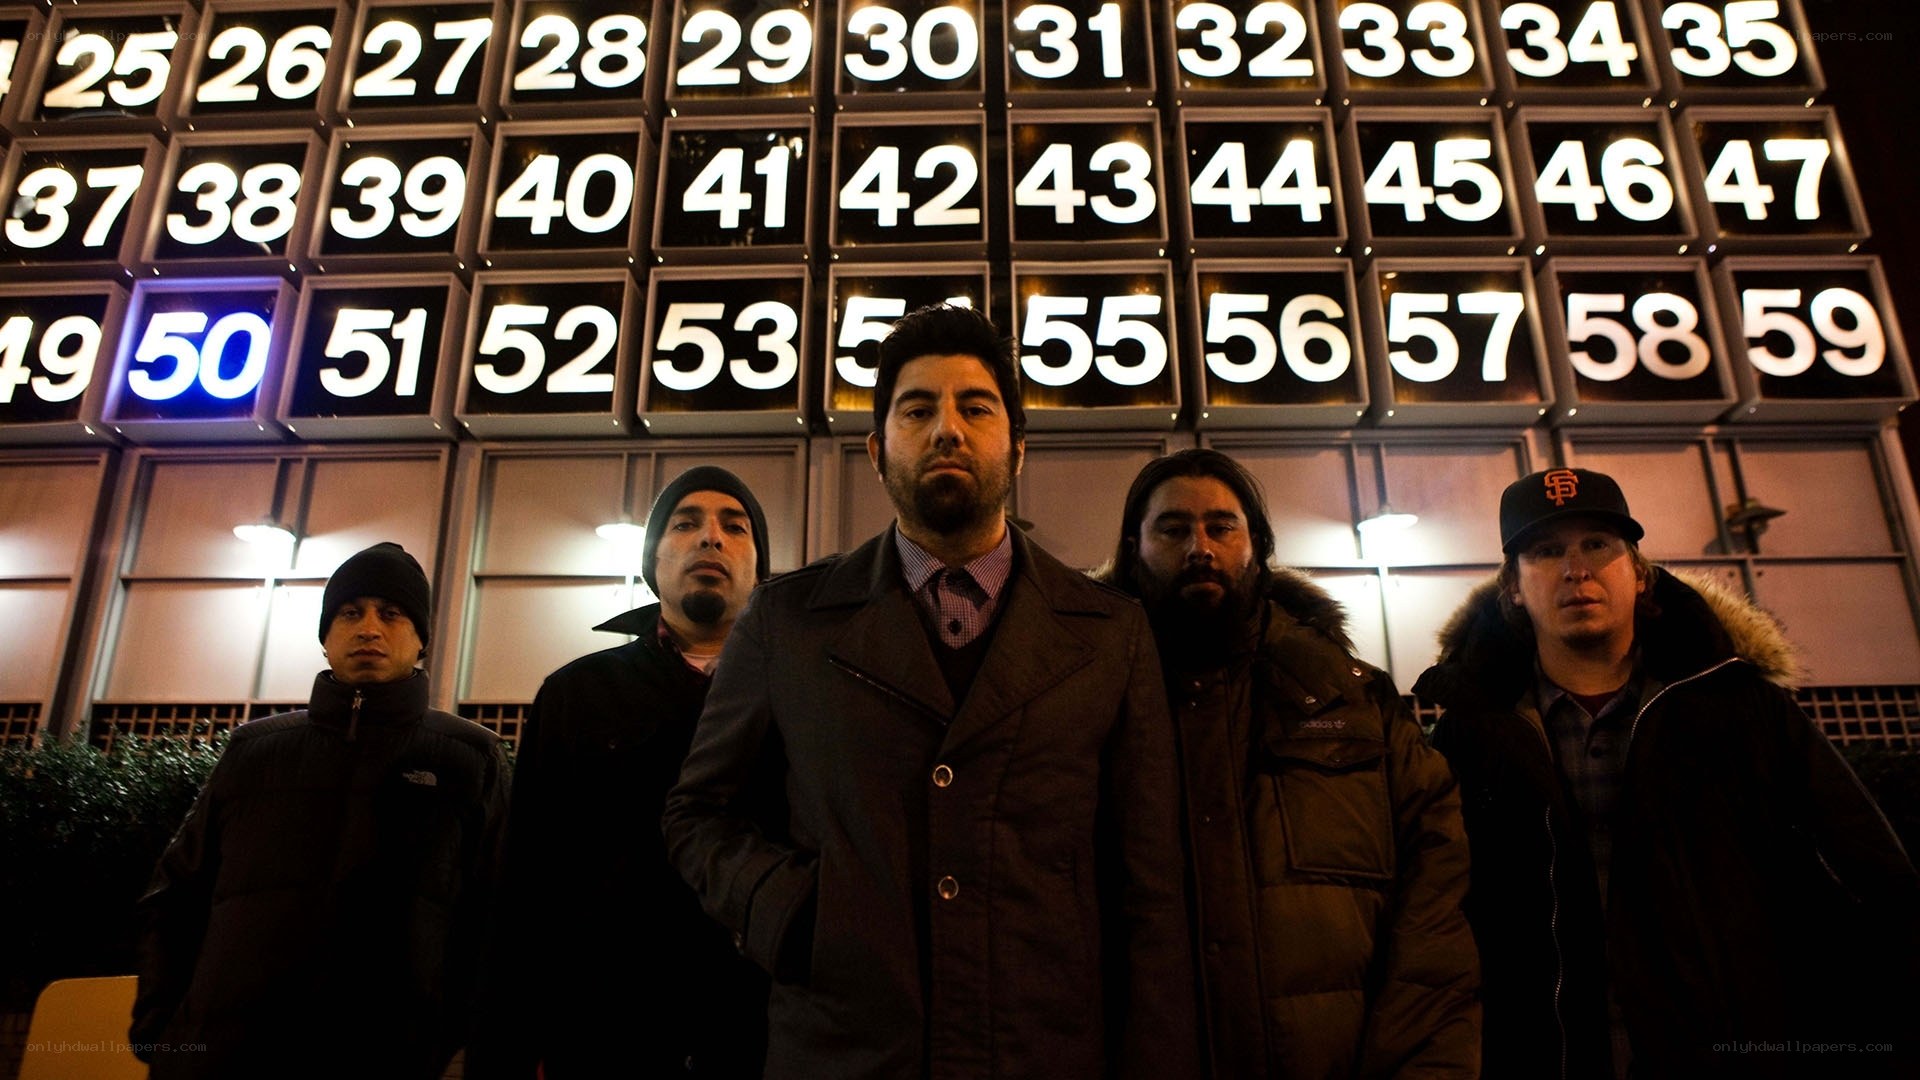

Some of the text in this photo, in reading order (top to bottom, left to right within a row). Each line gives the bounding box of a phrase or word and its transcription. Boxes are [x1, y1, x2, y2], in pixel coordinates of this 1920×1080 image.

[43, 31, 178, 107] 25
[196, 26, 333, 103] 26
[353, 18, 494, 97] 27
[514, 14, 647, 90] 28
[676, 9, 812, 86] 29
[844, 5, 979, 82] 30
[1014, 3, 1123, 79] 31
[1175, 2, 1314, 78] 32
[1338, 2, 1475, 77] 33
[1499, 1, 1638, 77] 34
[1661, 0, 1798, 77] 35
[5, 166, 144, 248] 37
[166, 162, 303, 244] 38
[330, 156, 467, 239] 39
[495, 153, 634, 234] 40
[682, 147, 790, 228] 41
[839, 145, 980, 227] 42
[1014, 142, 1156, 225] 43
[1190, 139, 1332, 223] 44
[1363, 138, 1503, 221] 45
[1534, 138, 1675, 221] 46
[1703, 138, 1831, 220] 47
[128, 311, 271, 401] 50
[319, 308, 427, 397] 51
[474, 304, 618, 394] 52
[652, 301, 798, 391] 53
[835, 296, 971, 387] 5
[1020, 294, 1168, 387] 55
[1205, 292, 1352, 383] 56
[1388, 291, 1525, 382] 57
[1567, 292, 1711, 381] 58
[1742, 287, 1886, 378] 59
